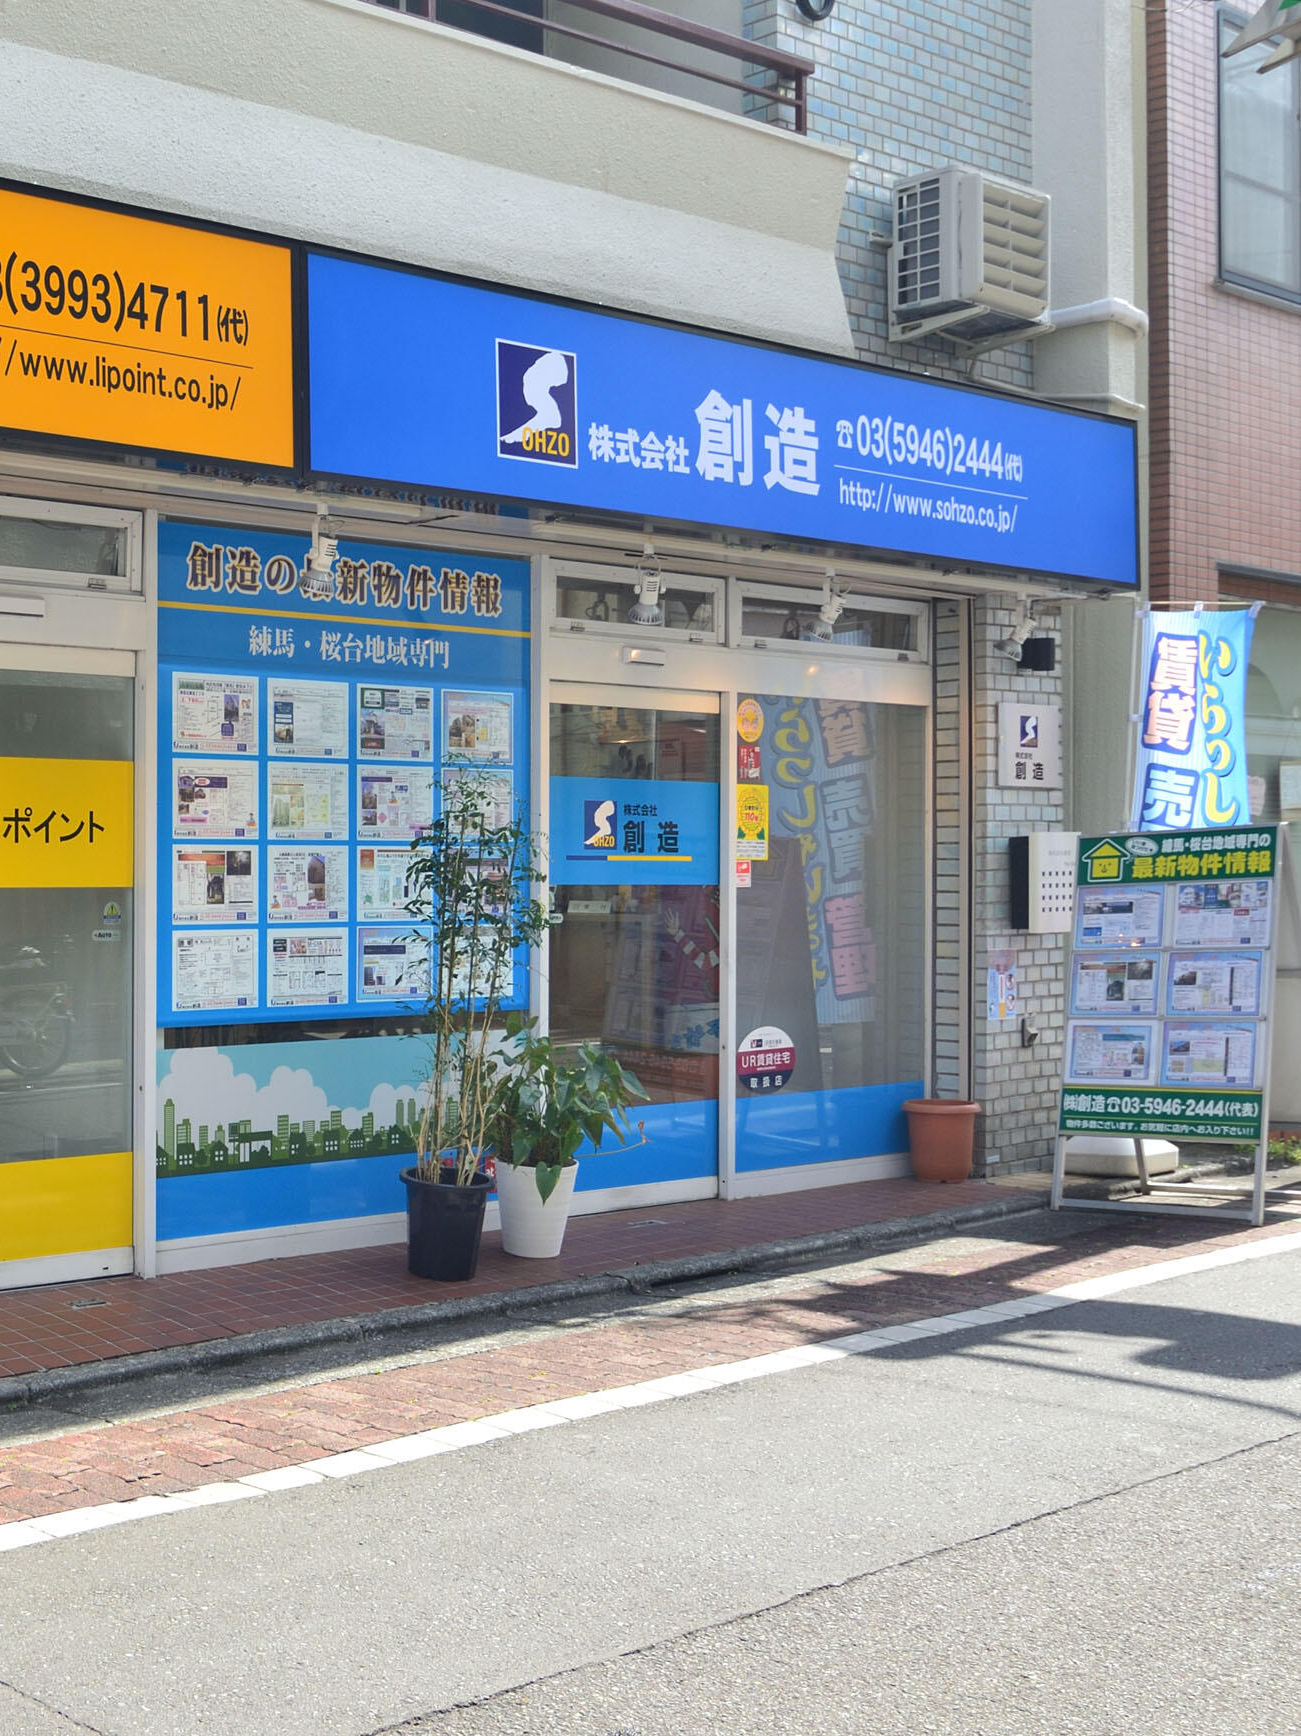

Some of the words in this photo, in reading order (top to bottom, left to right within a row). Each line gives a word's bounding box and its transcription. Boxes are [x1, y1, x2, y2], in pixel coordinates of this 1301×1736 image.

[588, 422, 691, 474] 株式会社
[695, 390, 822, 496] 創造
[187, 542, 503, 618] 創造の新物件情報
[1144, 637, 1198, 751] 賃貸
[623, 803, 658, 817] 株式会社
[1143, 768, 1196, 832] 売
[623, 820, 679, 853] 創造
[1131, 850, 1271, 878] 最新物件情報
[741, 1051, 791, 1069] UR賃貸住宅
